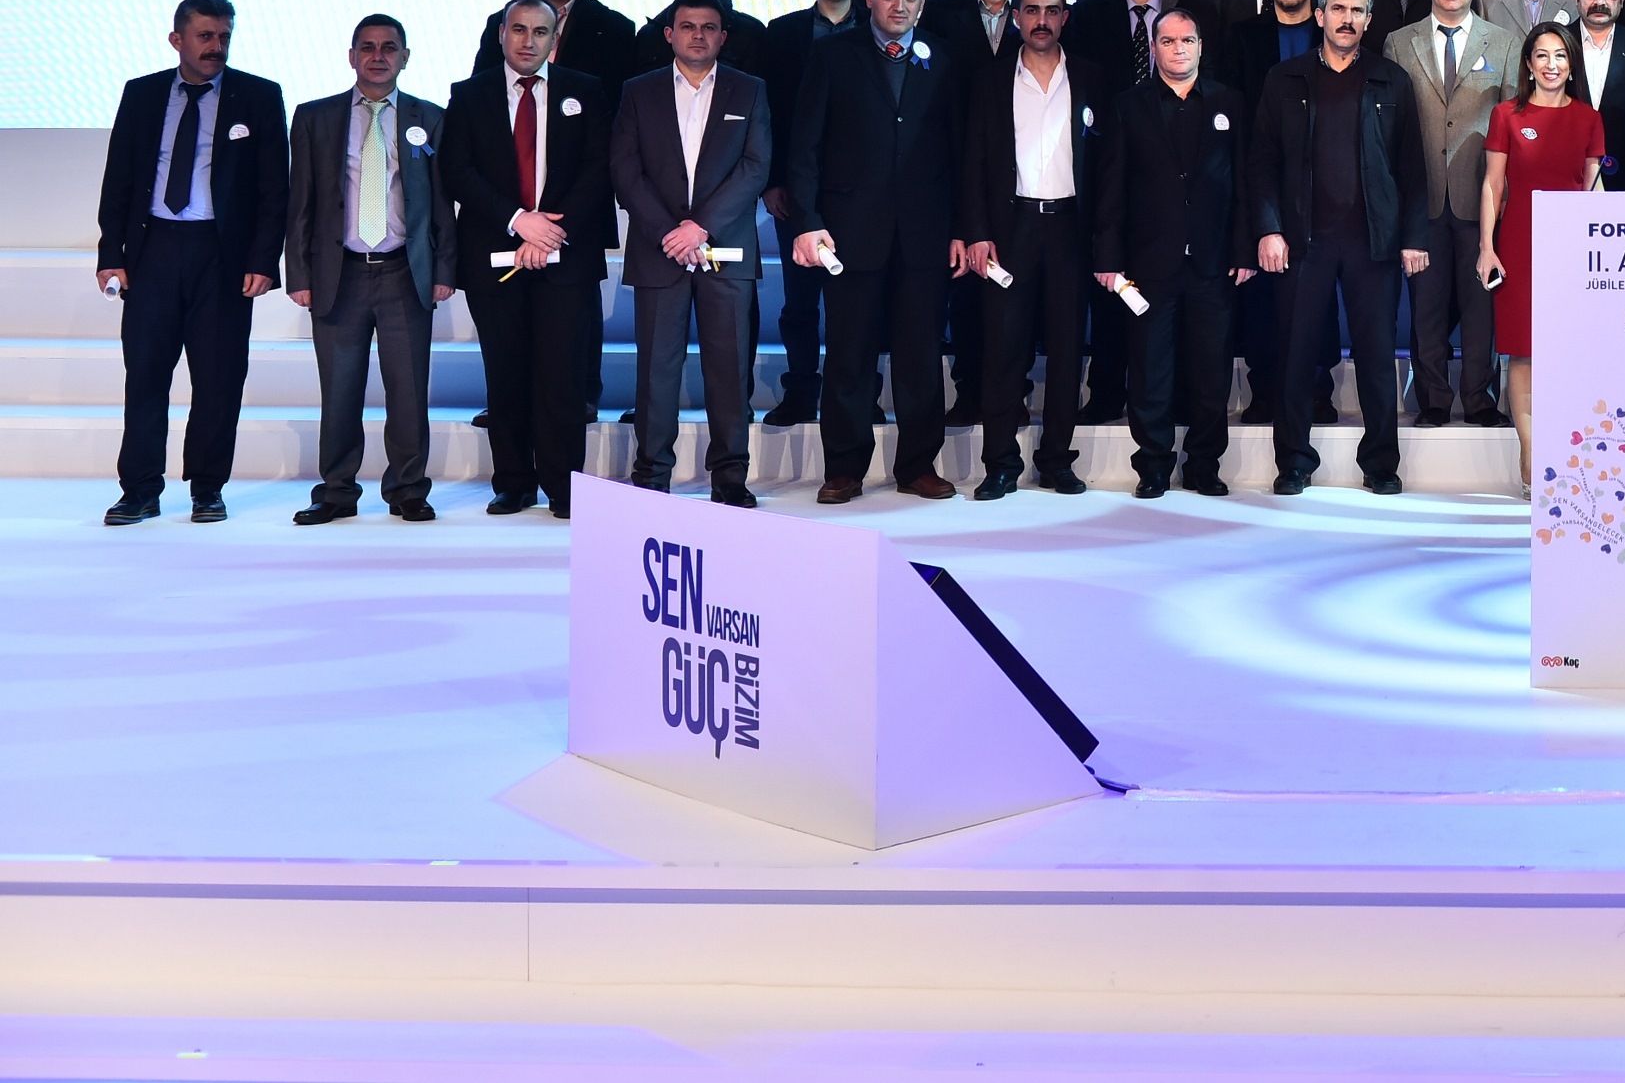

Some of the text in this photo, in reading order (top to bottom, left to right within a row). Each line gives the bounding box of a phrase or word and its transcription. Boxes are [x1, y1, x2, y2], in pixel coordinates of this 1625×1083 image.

[1588, 251, 1609, 272] II.
[1586, 278, 1625, 290] JÜBİLE
[1553, 497, 1568, 505] SEN
[642, 537, 760, 648] SEN VARSAN
[1564, 656, 1579, 668] Koç
[662, 637, 729, 760] GÜÇ
[734, 652, 760, 750] BİZİM
